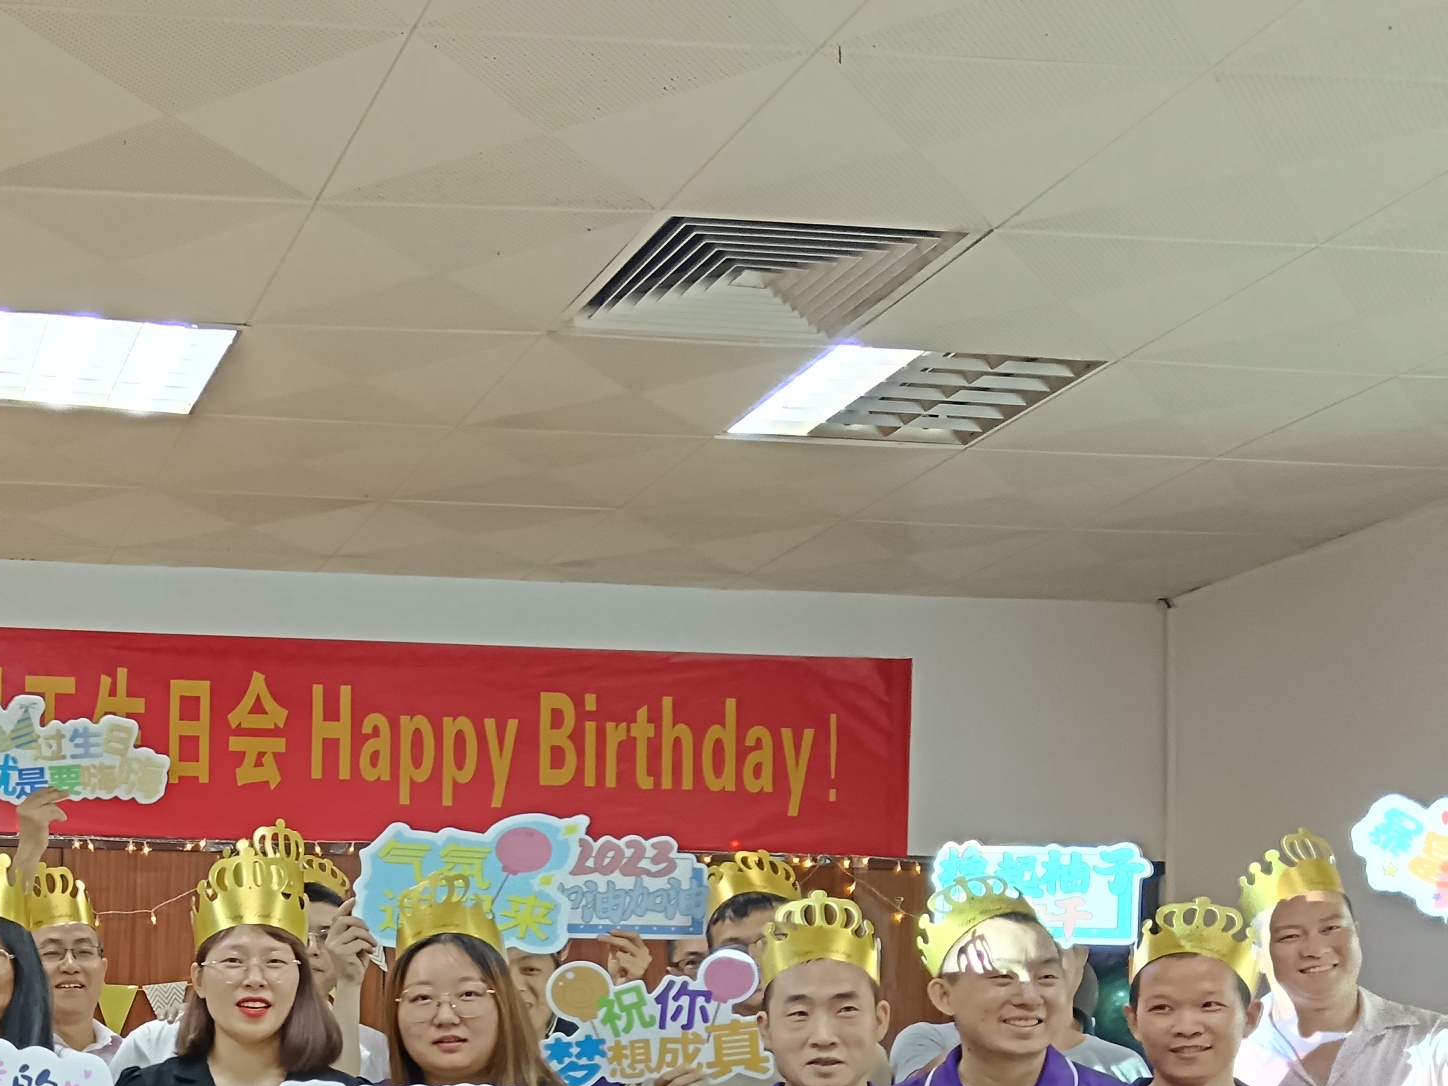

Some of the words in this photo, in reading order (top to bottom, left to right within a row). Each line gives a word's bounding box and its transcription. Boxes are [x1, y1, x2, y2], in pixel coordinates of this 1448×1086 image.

[33, 722, 134, 761] 过生日
[310, 683, 519, 807] Happy
[378, 840, 492, 890] 气氛
[569, 837, 678, 878] 2023
[596, 979, 713, 1038] 祝你
